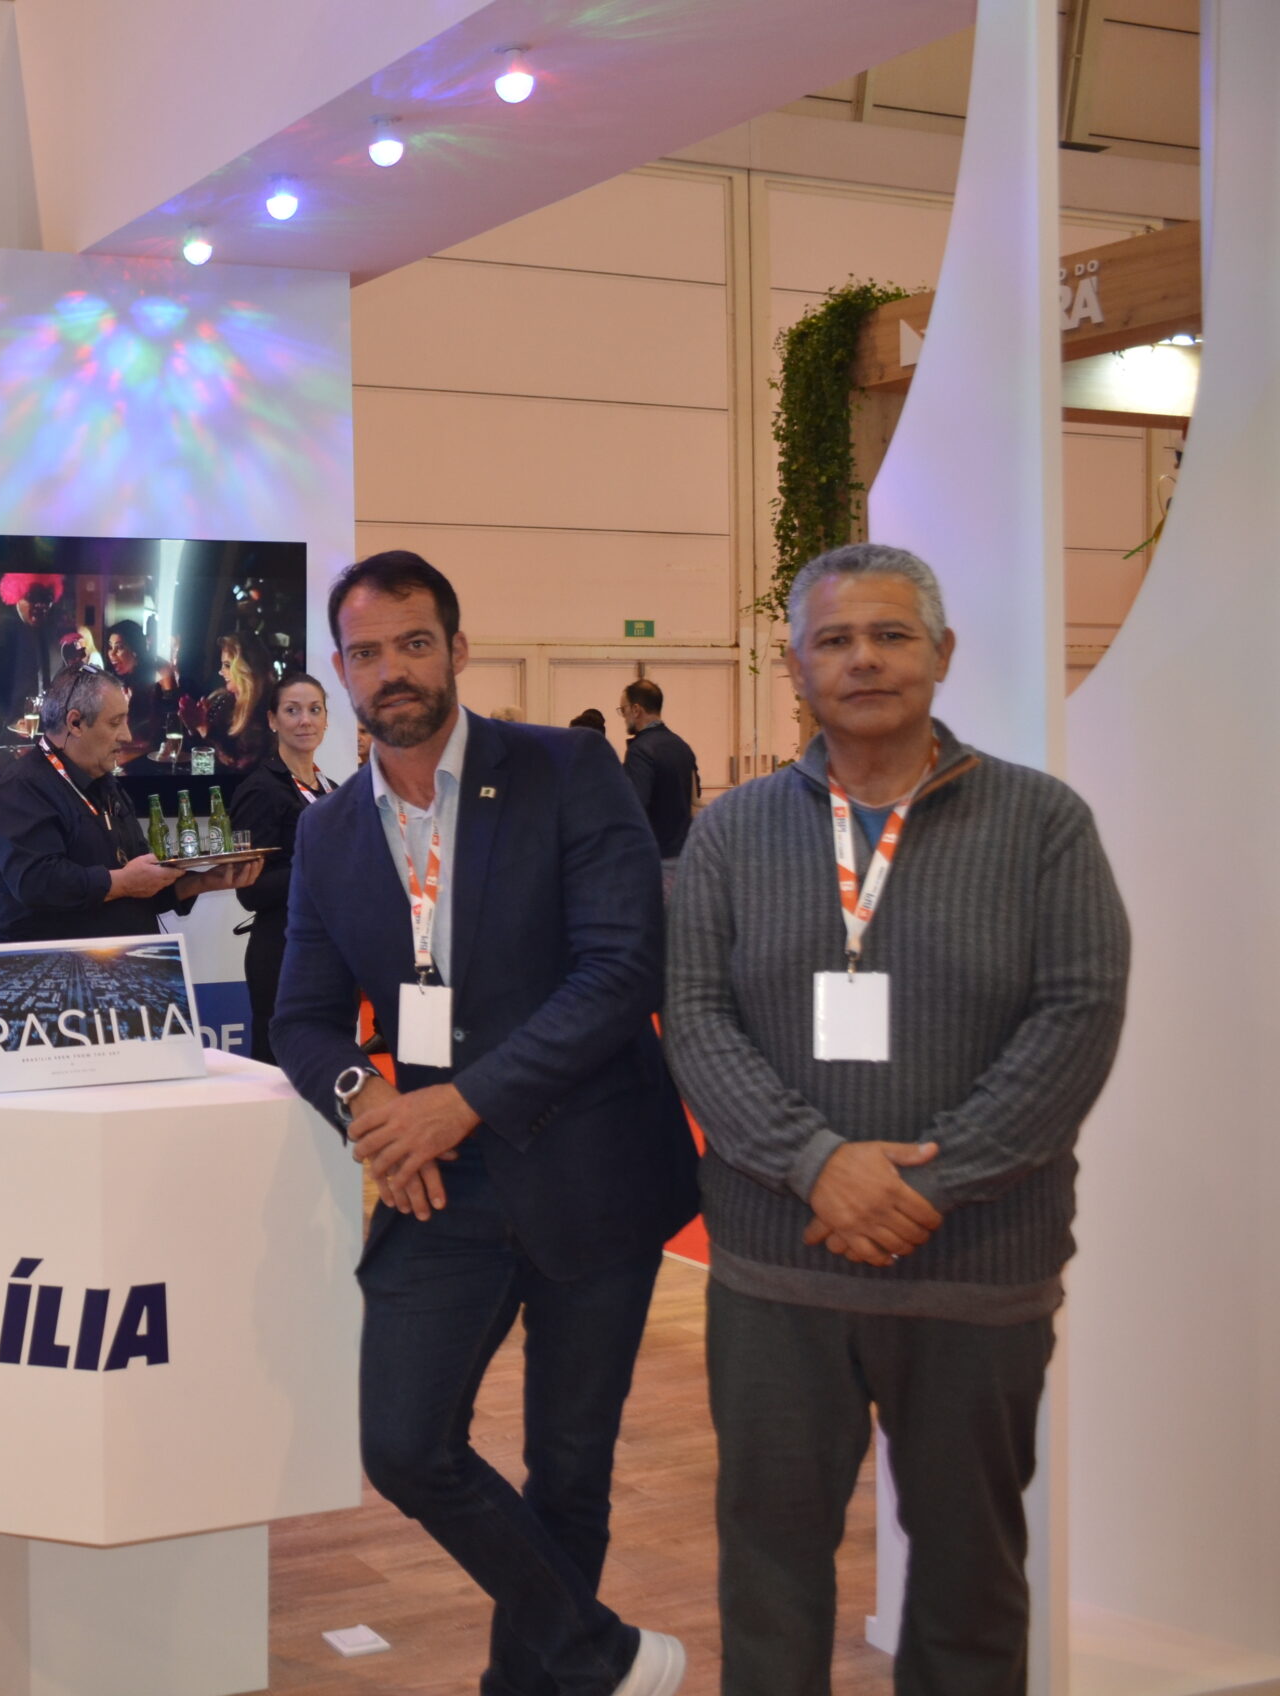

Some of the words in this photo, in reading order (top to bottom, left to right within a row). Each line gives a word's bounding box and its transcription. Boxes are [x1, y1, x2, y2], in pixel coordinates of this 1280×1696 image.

[1075, 259, 1099, 276] DO
[862, 893, 875, 909] BPI
[420, 935, 430, 951] BPI
